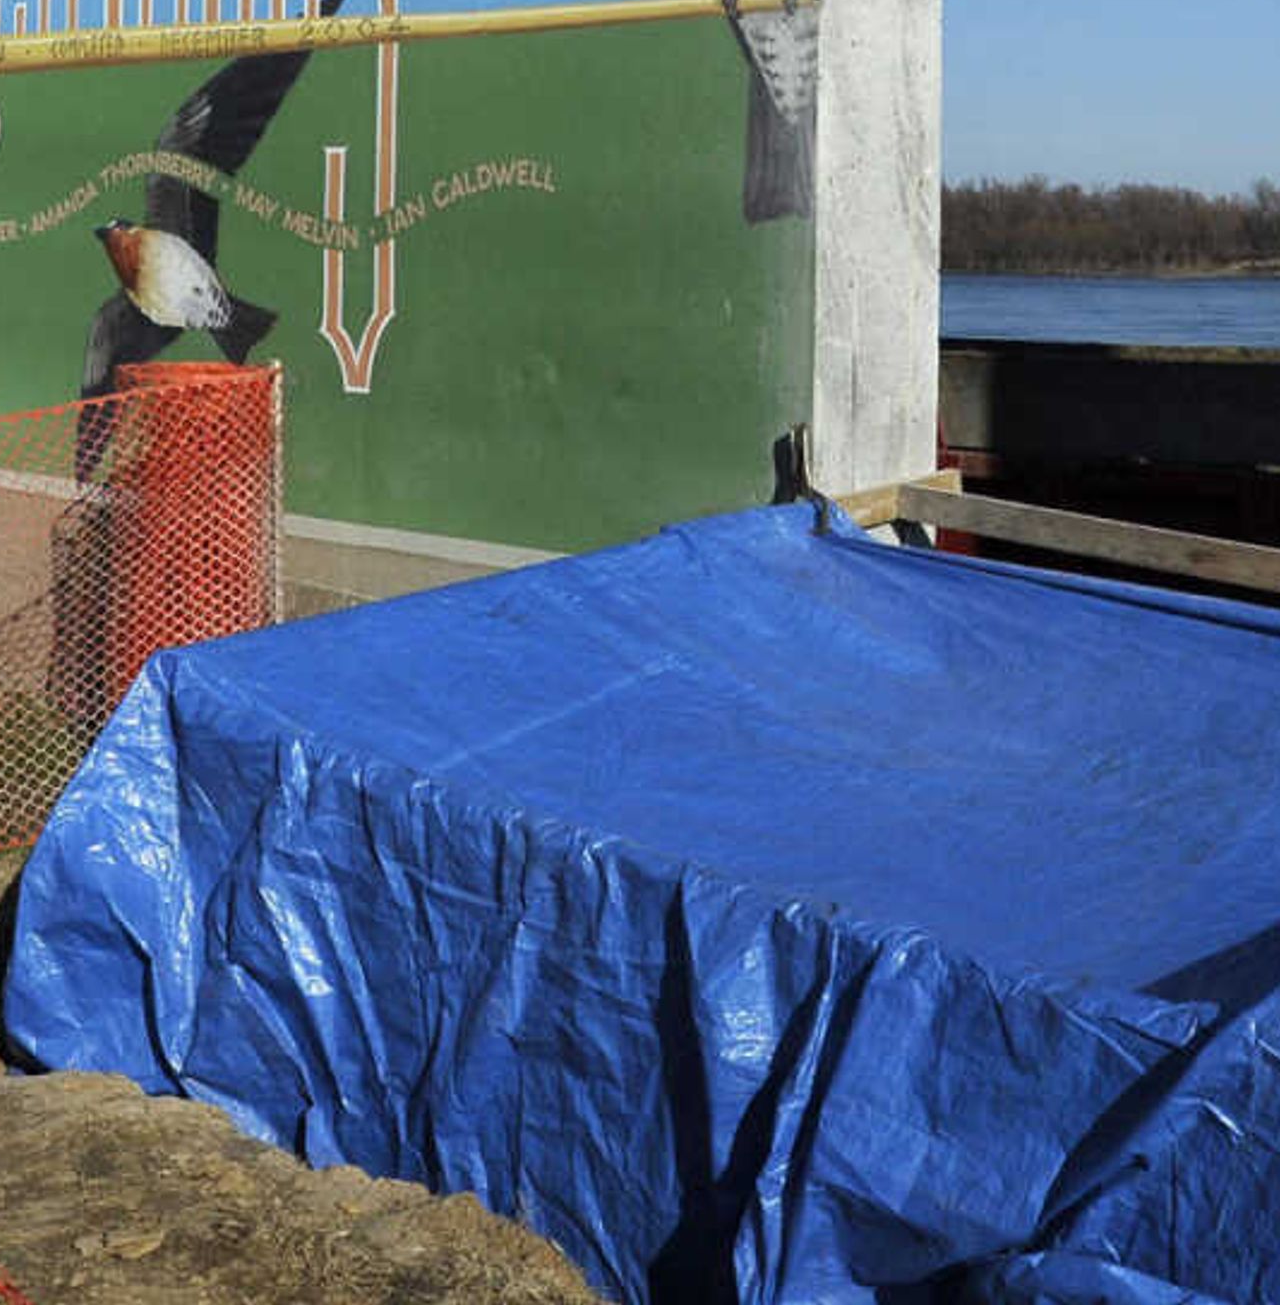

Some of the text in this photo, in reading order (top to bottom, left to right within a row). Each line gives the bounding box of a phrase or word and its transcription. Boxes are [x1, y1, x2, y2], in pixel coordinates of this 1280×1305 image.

[99, 150, 218, 191] THORNBERRY
[234, 184, 280, 223] MAY
[281, 209, 360, 251] MELVIN
[432, 158, 557, 209] CALDWELL
